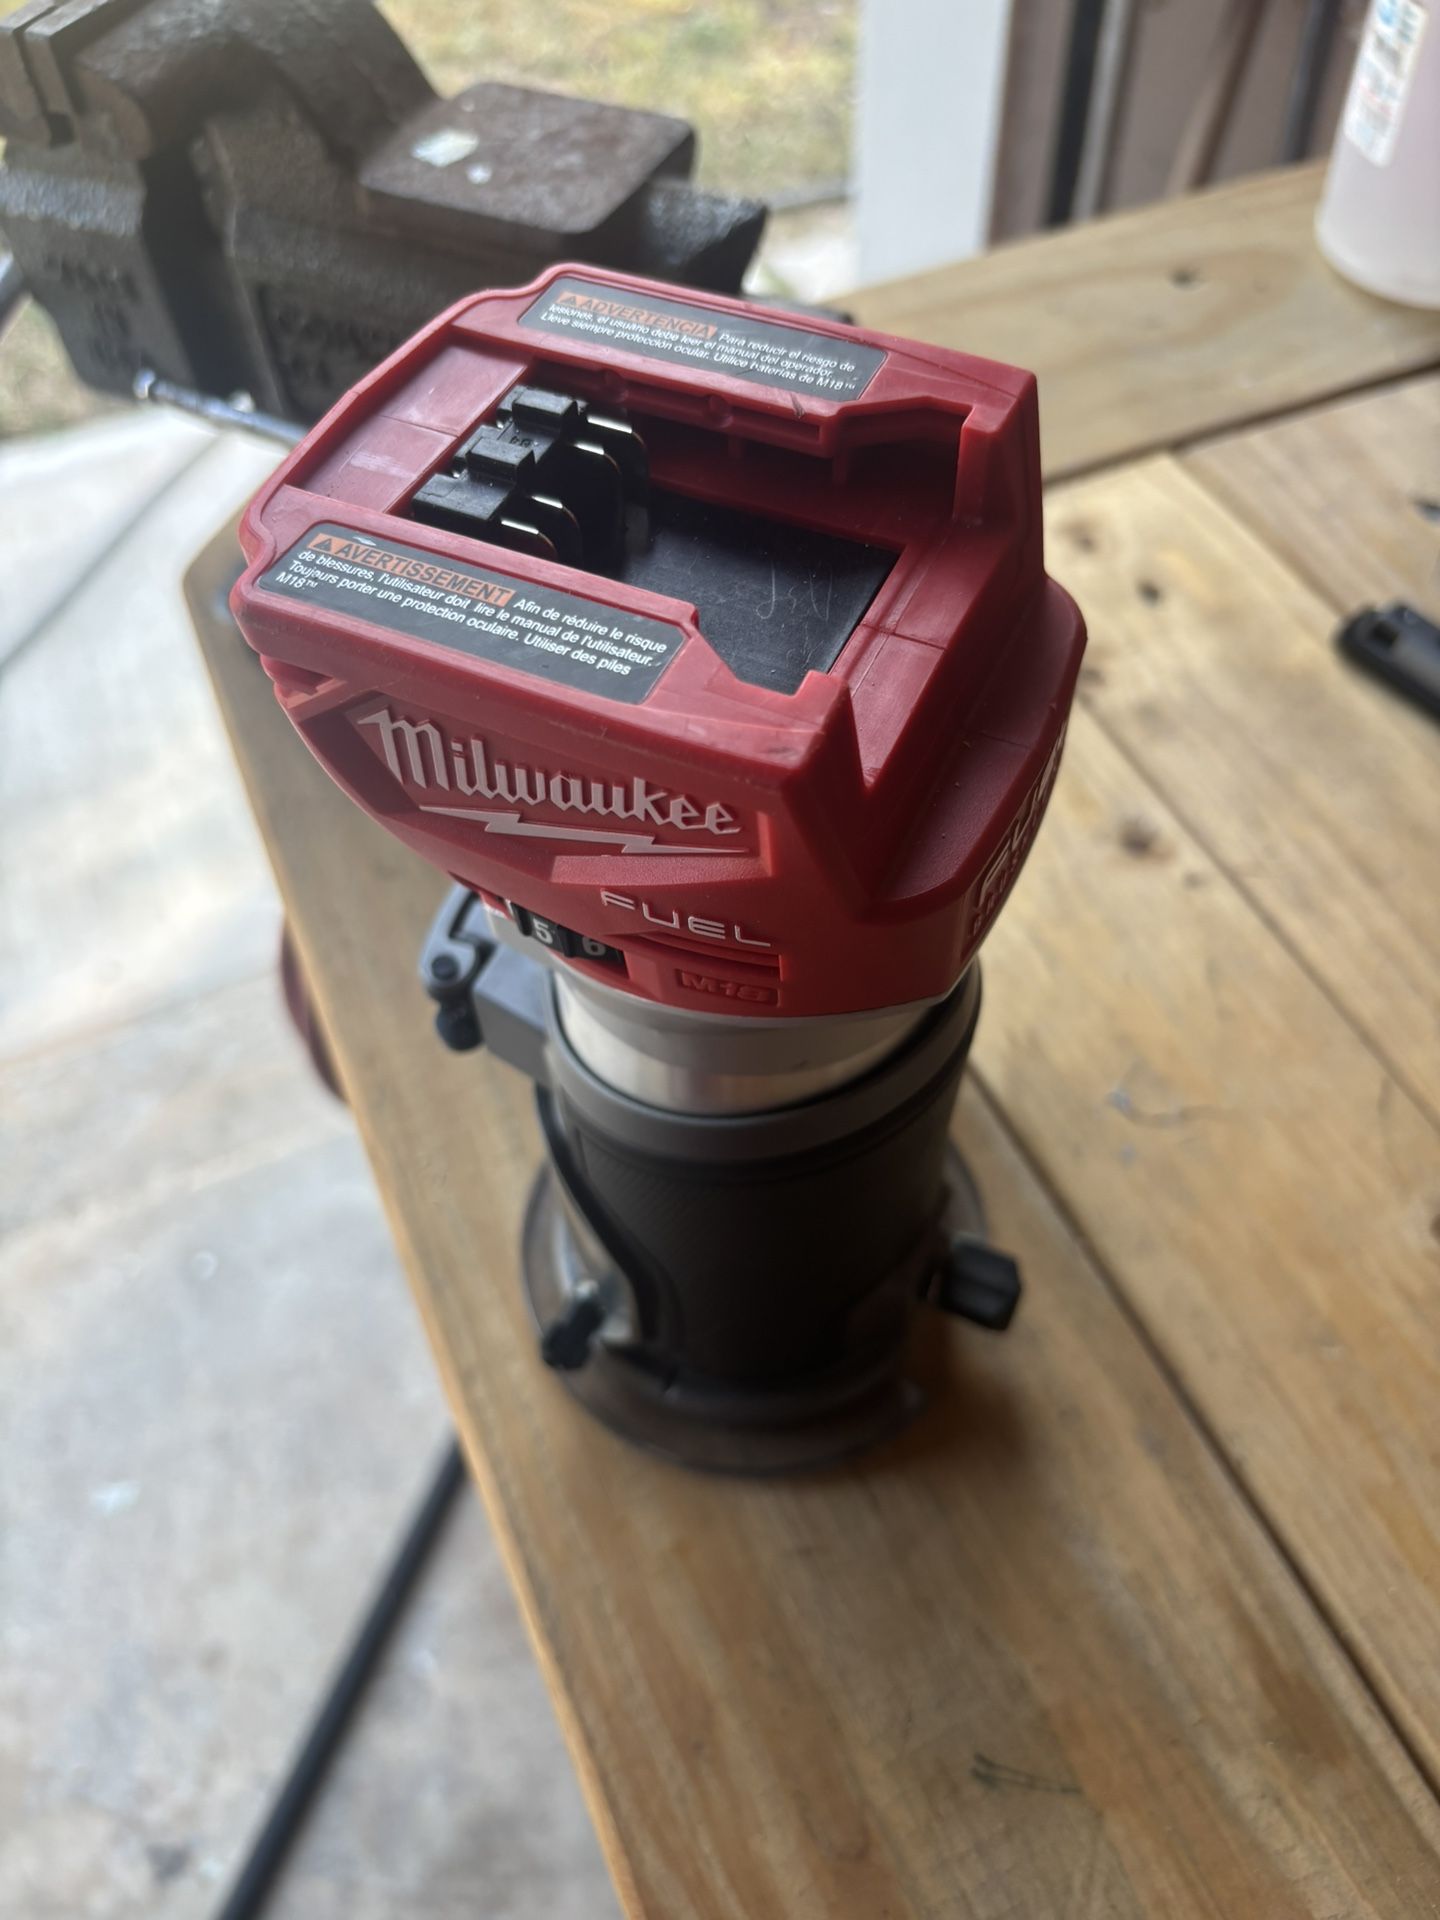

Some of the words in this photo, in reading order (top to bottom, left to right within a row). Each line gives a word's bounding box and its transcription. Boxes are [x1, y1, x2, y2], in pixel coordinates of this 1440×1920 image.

[540, 312, 571, 326] Lleve
[571, 319, 616, 336] siempre
[614, 330, 673, 350] protección
[673, 344, 710, 360] ocular.
[713, 352, 749, 368] Utilice
[798, 374, 815, 384] de
[579, 299, 709, 338] ADVERTENCIA
[719, 333, 746, 346] Para
[748, 341, 787, 356] reducir
[789, 350, 802, 360] el
[802, 353, 838, 368] riesgo
[839, 362, 856, 372] de
[597, 316, 610, 324] el
[609, 319, 650, 334] usuario
[651, 328, 680, 342] debe
[680, 335, 703, 346] leer
[703, 341, 717, 350] el
[716, 344, 761, 360] manual
[760, 354, 780, 365] del
[780, 360, 833, 378] operador.
[288, 560, 340, 585] Toujours
[336, 578, 378, 596] porter
[377, 589, 403, 604] une
[400, 597, 467, 624] protection
[466, 617, 520, 642] oculaire.
[523, 632, 572, 656] Utiliser
[570, 649, 598, 665] des
[596, 657, 632, 676] piles
[298, 550, 316, 562] de
[315, 554, 376, 582] blessures,
[377, 572, 446, 601] l'utilisateur
[444, 594, 472, 610] doit
[473, 601, 496, 617] lire
[496, 609, 511, 622] le
[510, 615, 563, 638] manual
[561, 630, 580, 643] de
[580, 635, 654, 667] l'utilisateur.
[334, 543, 512, 603] AVERTISSEMENT
[513, 598, 541, 615] Afin
[542, 608, 561, 621] de
[561, 614, 609, 636] réduire
[609, 627, 624, 640] le
[625, 633, 668, 653] risque
[357, 708, 742, 836] Milwaukee
[532, 917, 554, 945] 5
[582, 934, 606, 957] 6
[600, 888, 772, 948] FUEL
